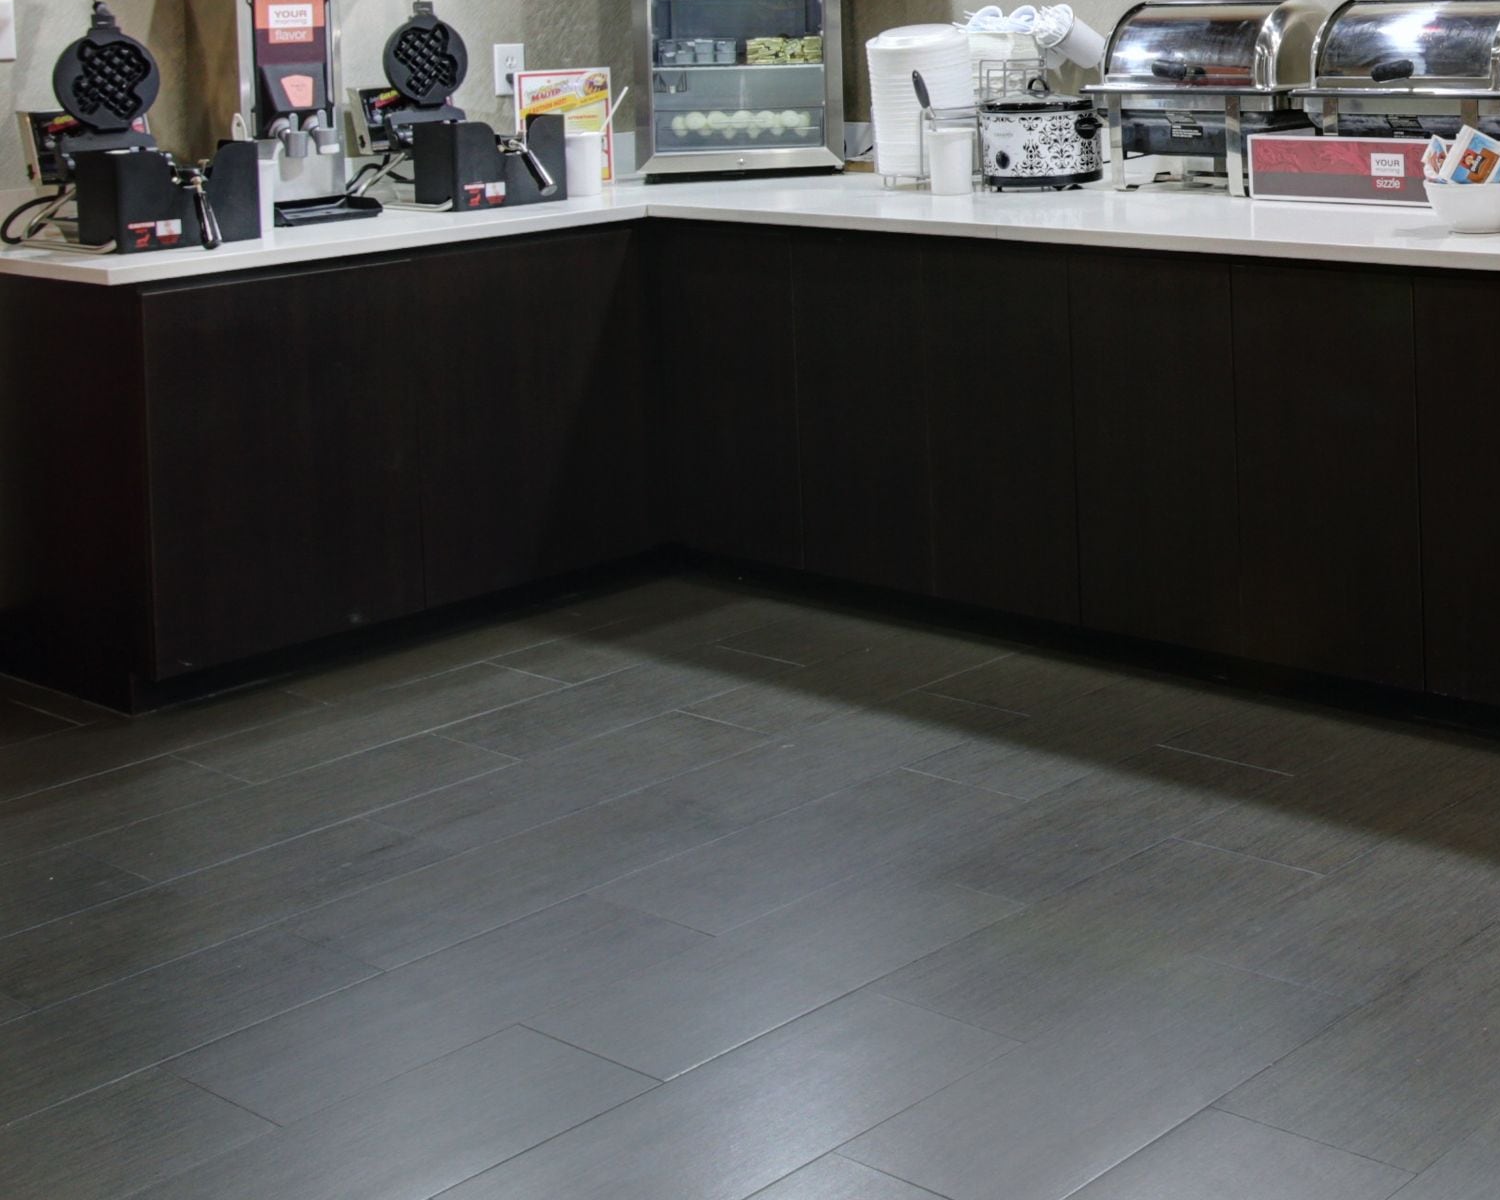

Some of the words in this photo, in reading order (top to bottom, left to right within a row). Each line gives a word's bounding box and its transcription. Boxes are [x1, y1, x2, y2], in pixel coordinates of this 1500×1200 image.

[273, 9, 308, 19] YOUR
[275, 29, 307, 40] flavor
[1375, 159, 1400, 167] YOUR
[1376, 177, 1401, 189] sizzle
